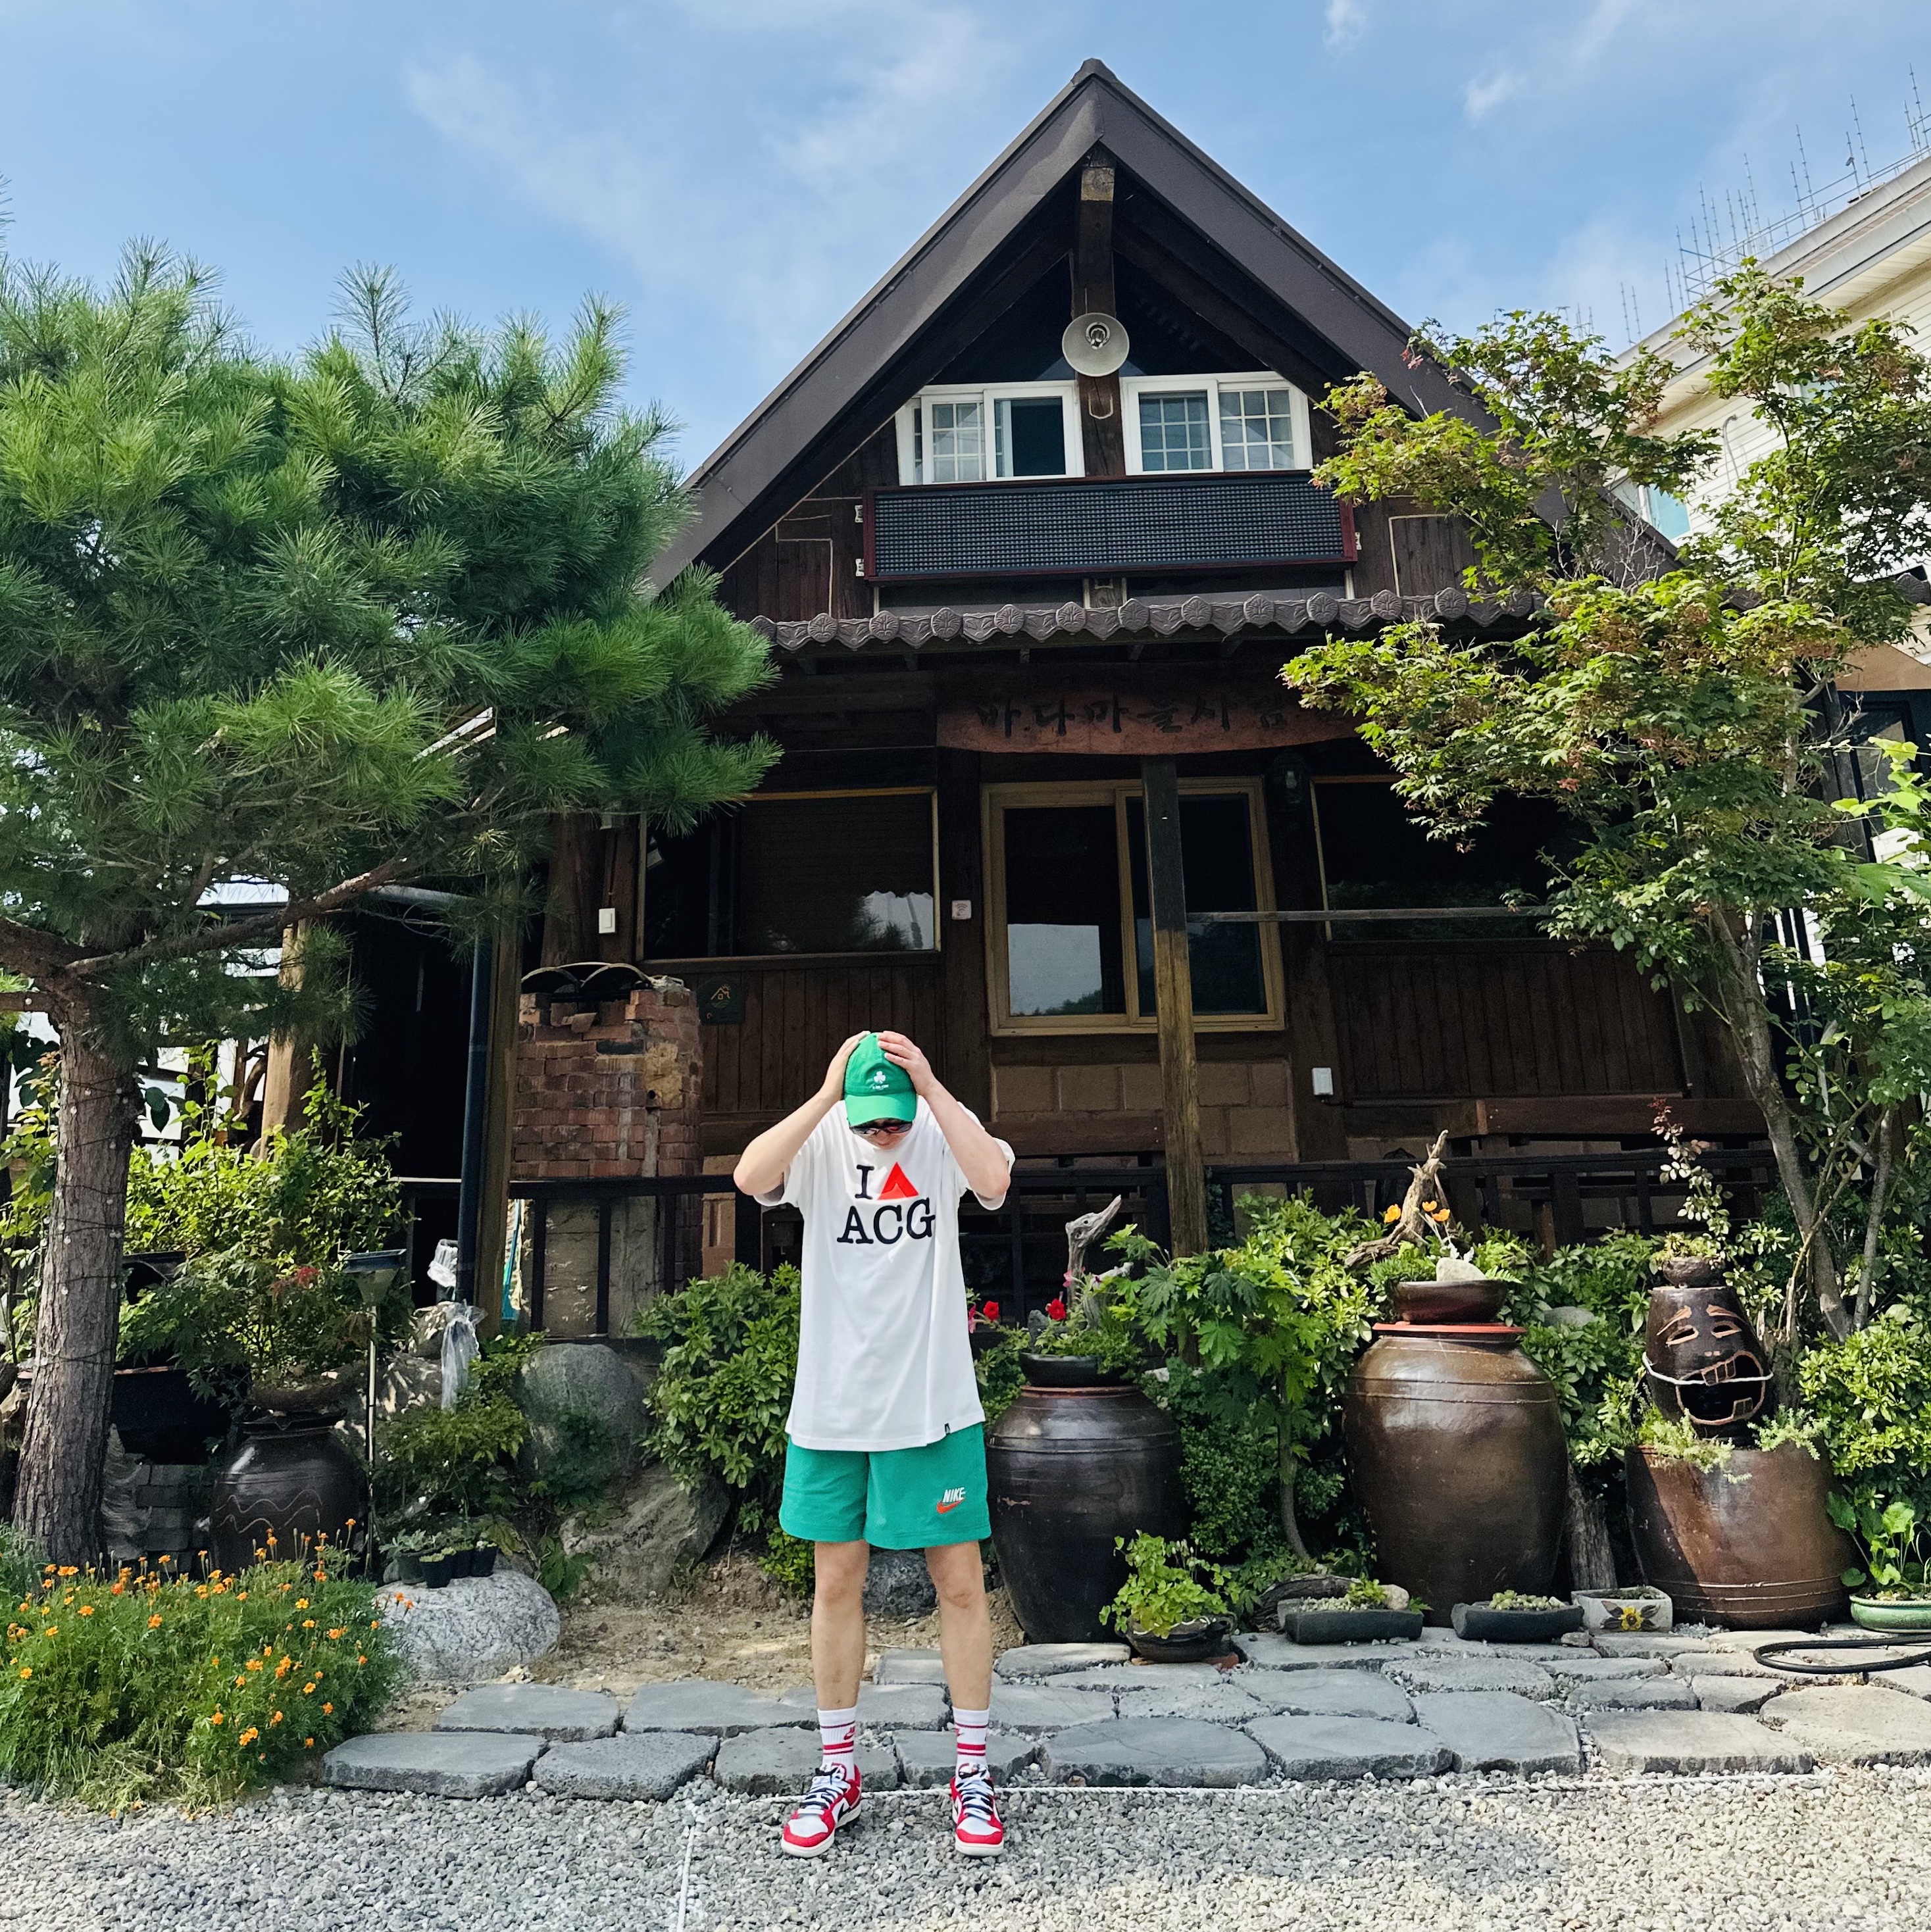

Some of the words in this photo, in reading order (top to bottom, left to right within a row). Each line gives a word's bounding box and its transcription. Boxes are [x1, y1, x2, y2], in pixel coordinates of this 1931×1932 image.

[855, 1164, 874, 1199] I
[836, 1197, 936, 1245] ACG
[942, 1487, 966, 1502] NIKE
